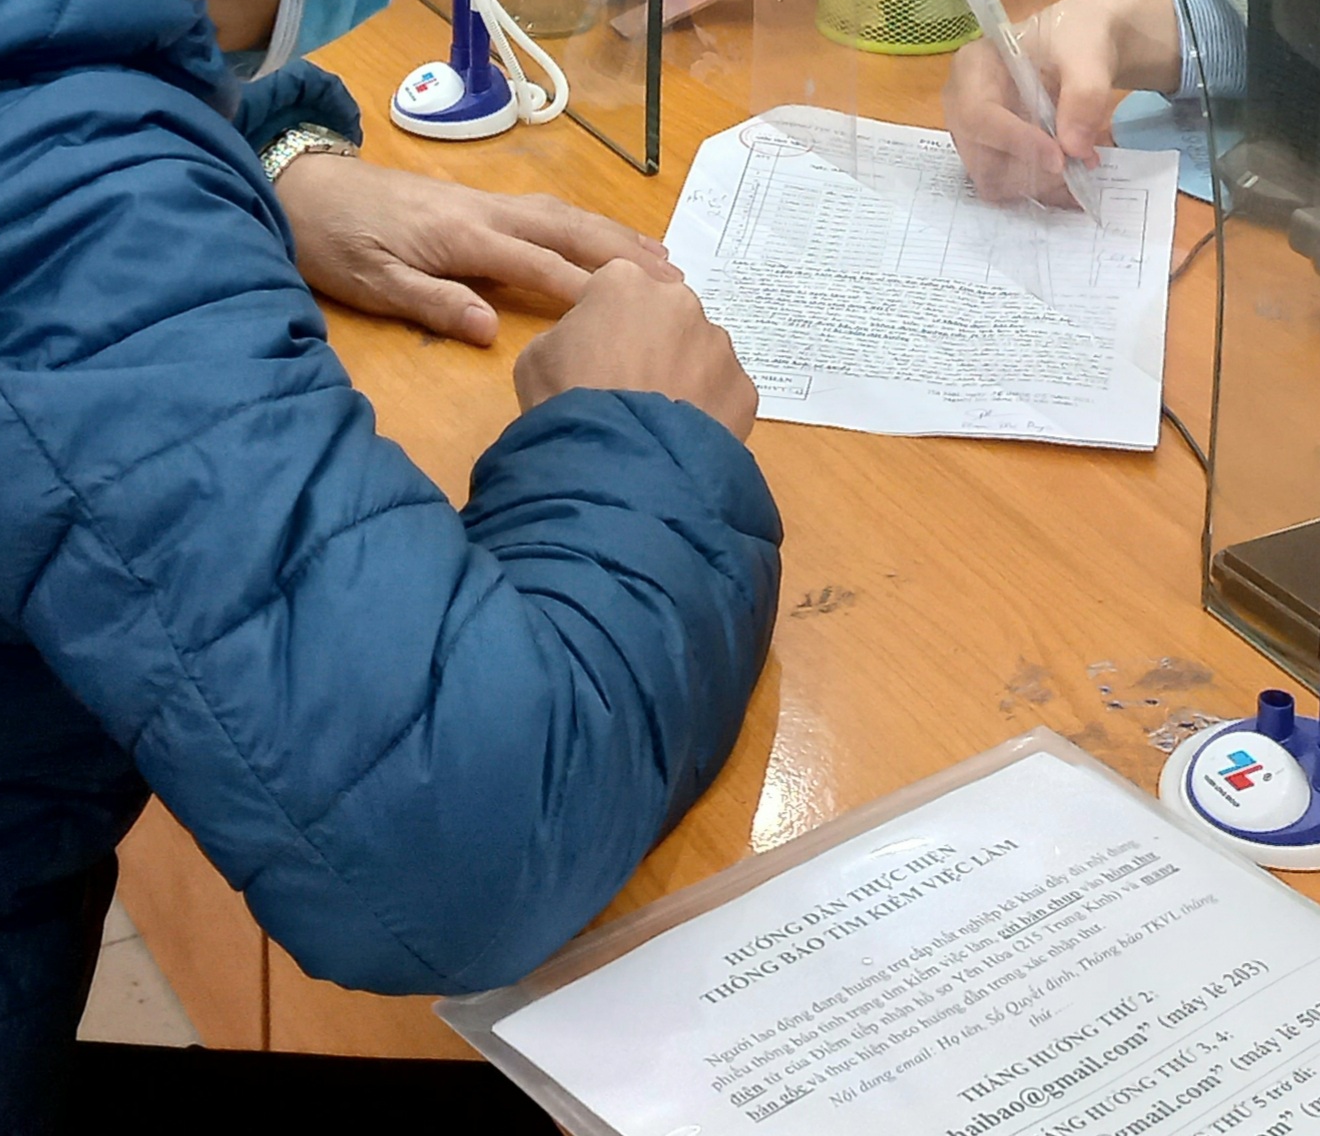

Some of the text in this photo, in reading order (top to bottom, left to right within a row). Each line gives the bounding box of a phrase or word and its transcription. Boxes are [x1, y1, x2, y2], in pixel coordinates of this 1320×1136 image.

[699, 840, 1019, 1003] THÔNG BÁO TÌM KIẾM VIỆC LÀM
[723, 922, 804, 966] HƯỚNG
[847, 869, 907, 902] THỰC
[904, 844, 957, 873] HIỆN
[1157, 996, 1208, 1029] (máy
[1202, 982, 1227, 999] lẻ
[1223, 960, 1269, 987] 203)
[957, 1063, 1030, 1102] THÁNG
[1027, 1025, 1099, 1068] HƯỞNG
[1096, 996, 1137, 1026] THỨ
[1084, 1077, 1157, 1121] HƯỞNG
[1154, 1049, 1197, 1078] THỨ
[1196, 1042, 1219, 1054] 3,
[1215, 1031, 1234, 1042] 4:
[1230, 1037, 1282, 1071] (máy
[1275, 1023, 1301, 1040] lẻ
[1208, 1068, 1317, 1134] THỨ 5 trở đi:
